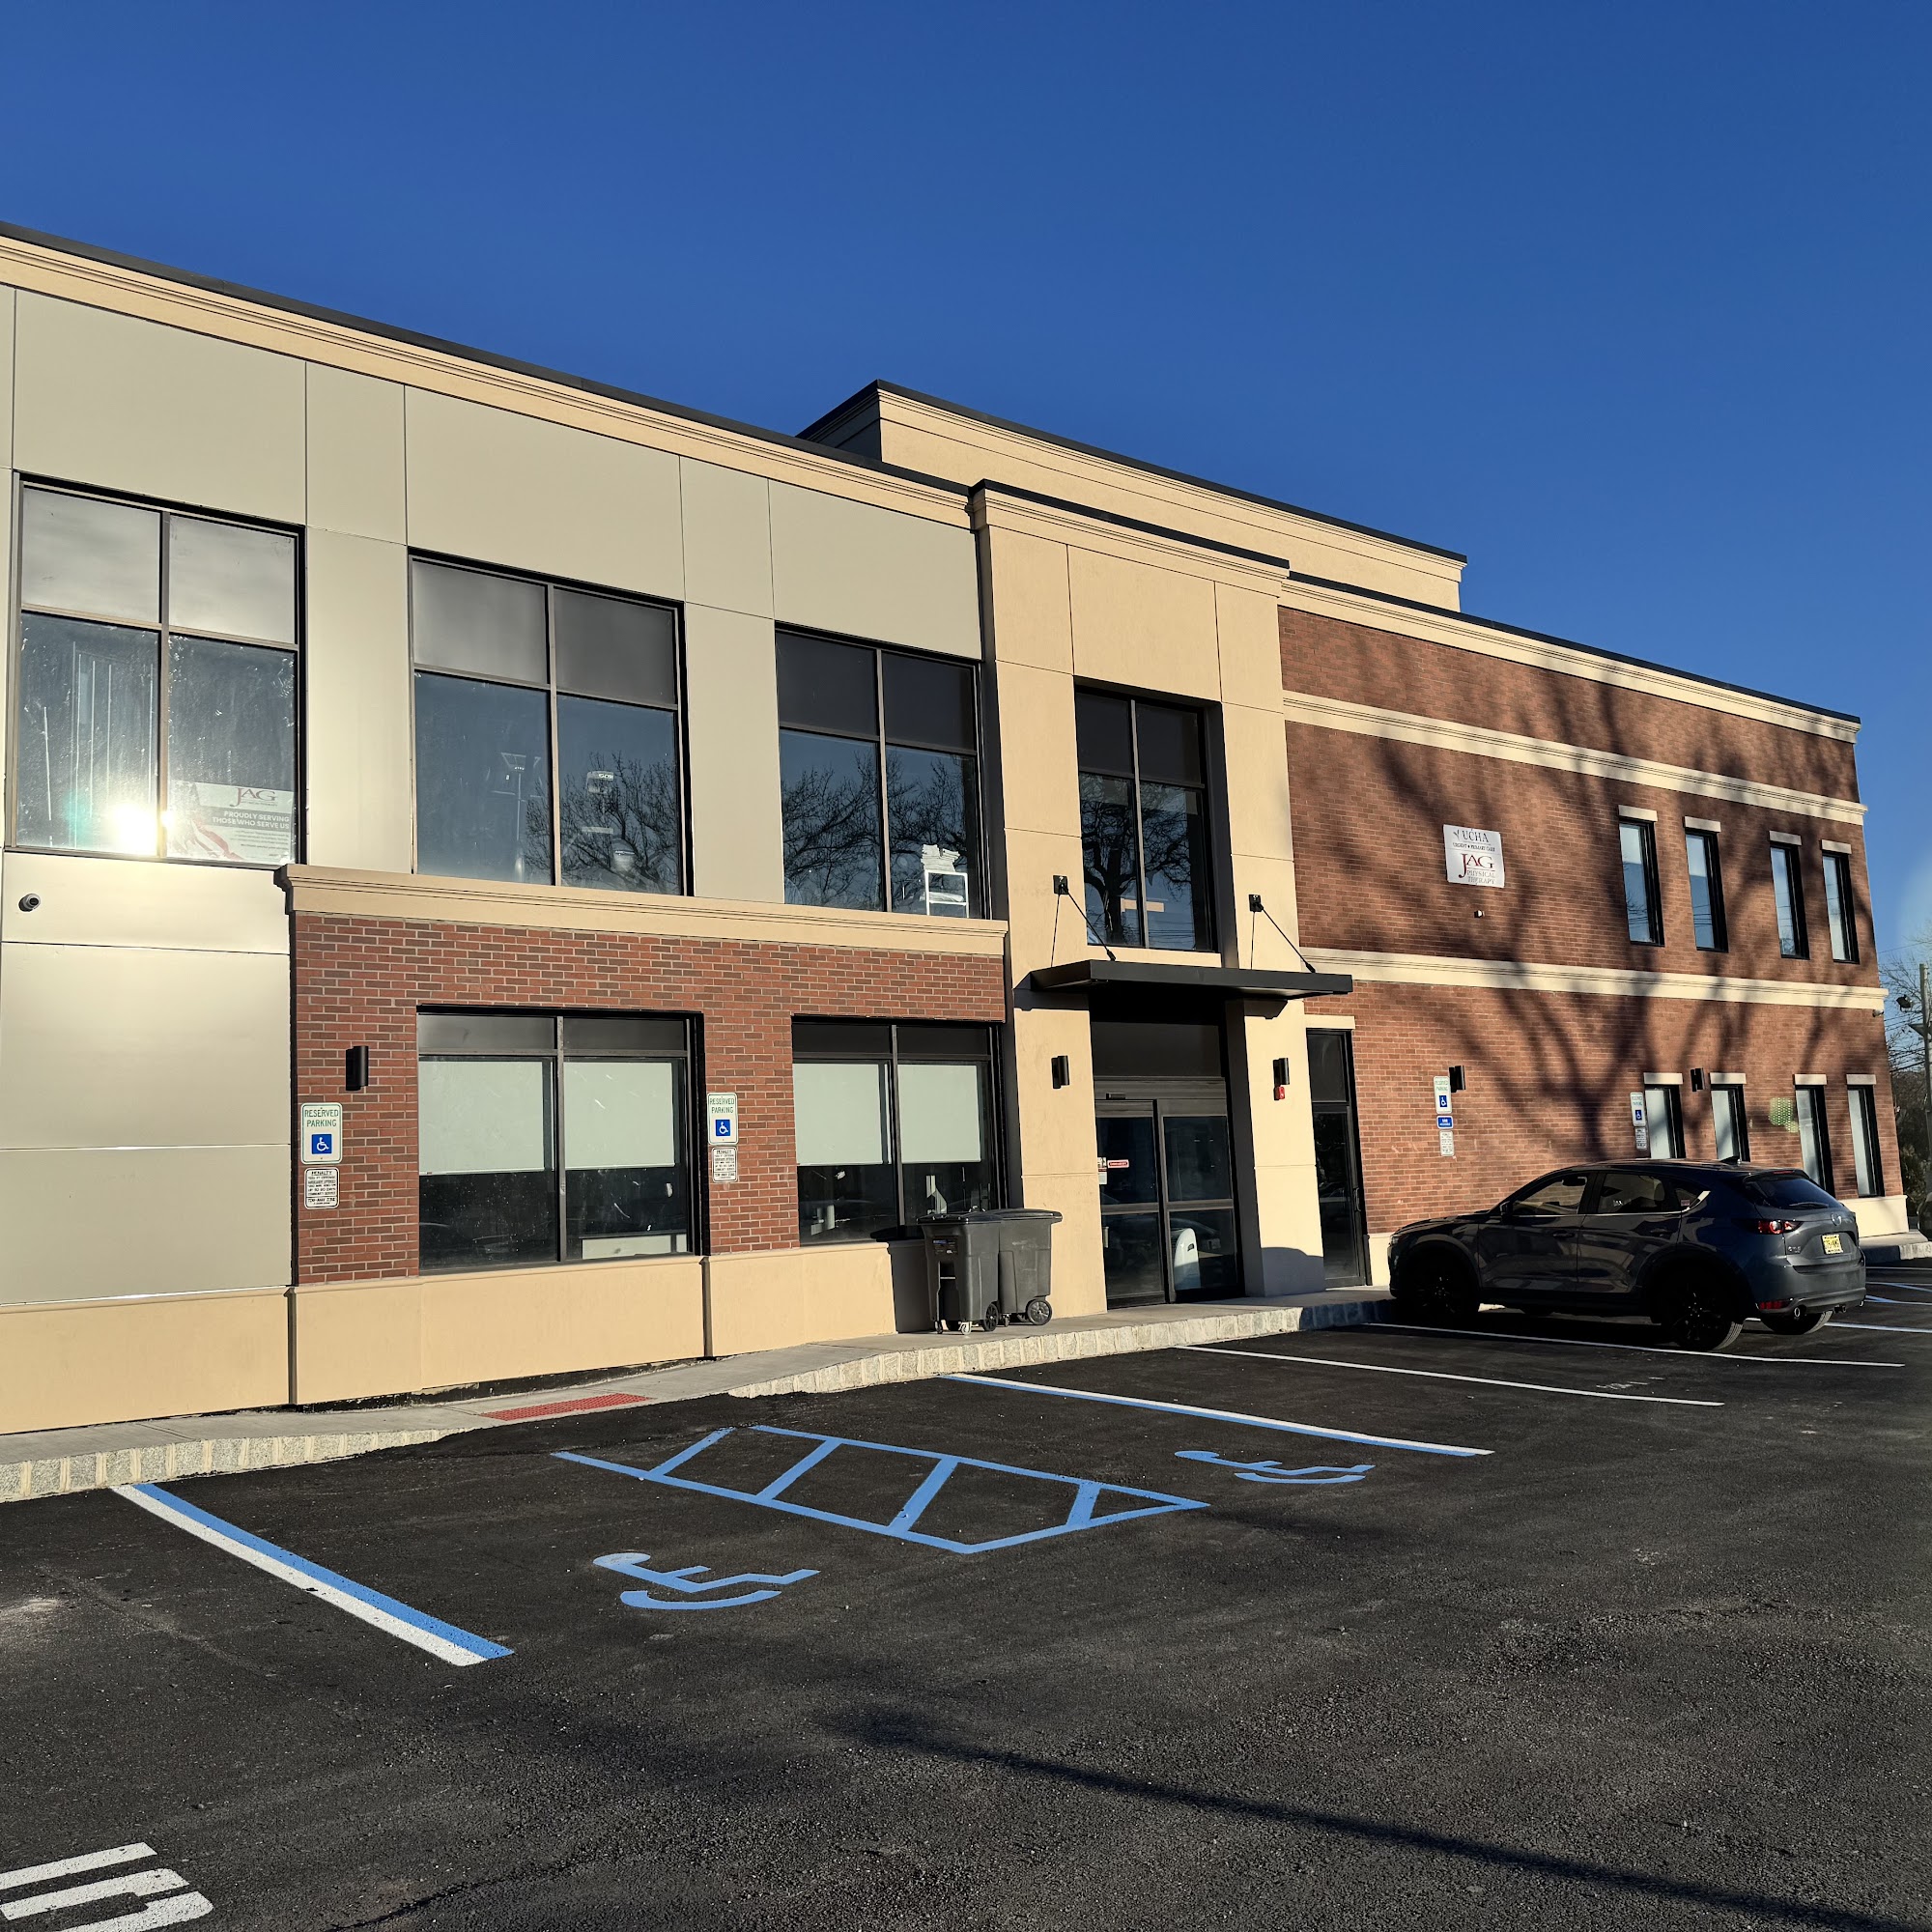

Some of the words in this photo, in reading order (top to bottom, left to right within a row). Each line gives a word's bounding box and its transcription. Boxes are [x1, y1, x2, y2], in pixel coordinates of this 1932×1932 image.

[229, 787, 278, 807] JAG
[224, 810, 258, 819] PROUDLY
[212, 816, 237, 825] THOSE
[257, 820, 279, 829] SERVE
[1459, 854, 1495, 878] JAG
[1467, 876, 1495, 885] THERAPY
[304, 1109, 339, 1118] RESERVED
[306, 1119, 337, 1127] PARKING
